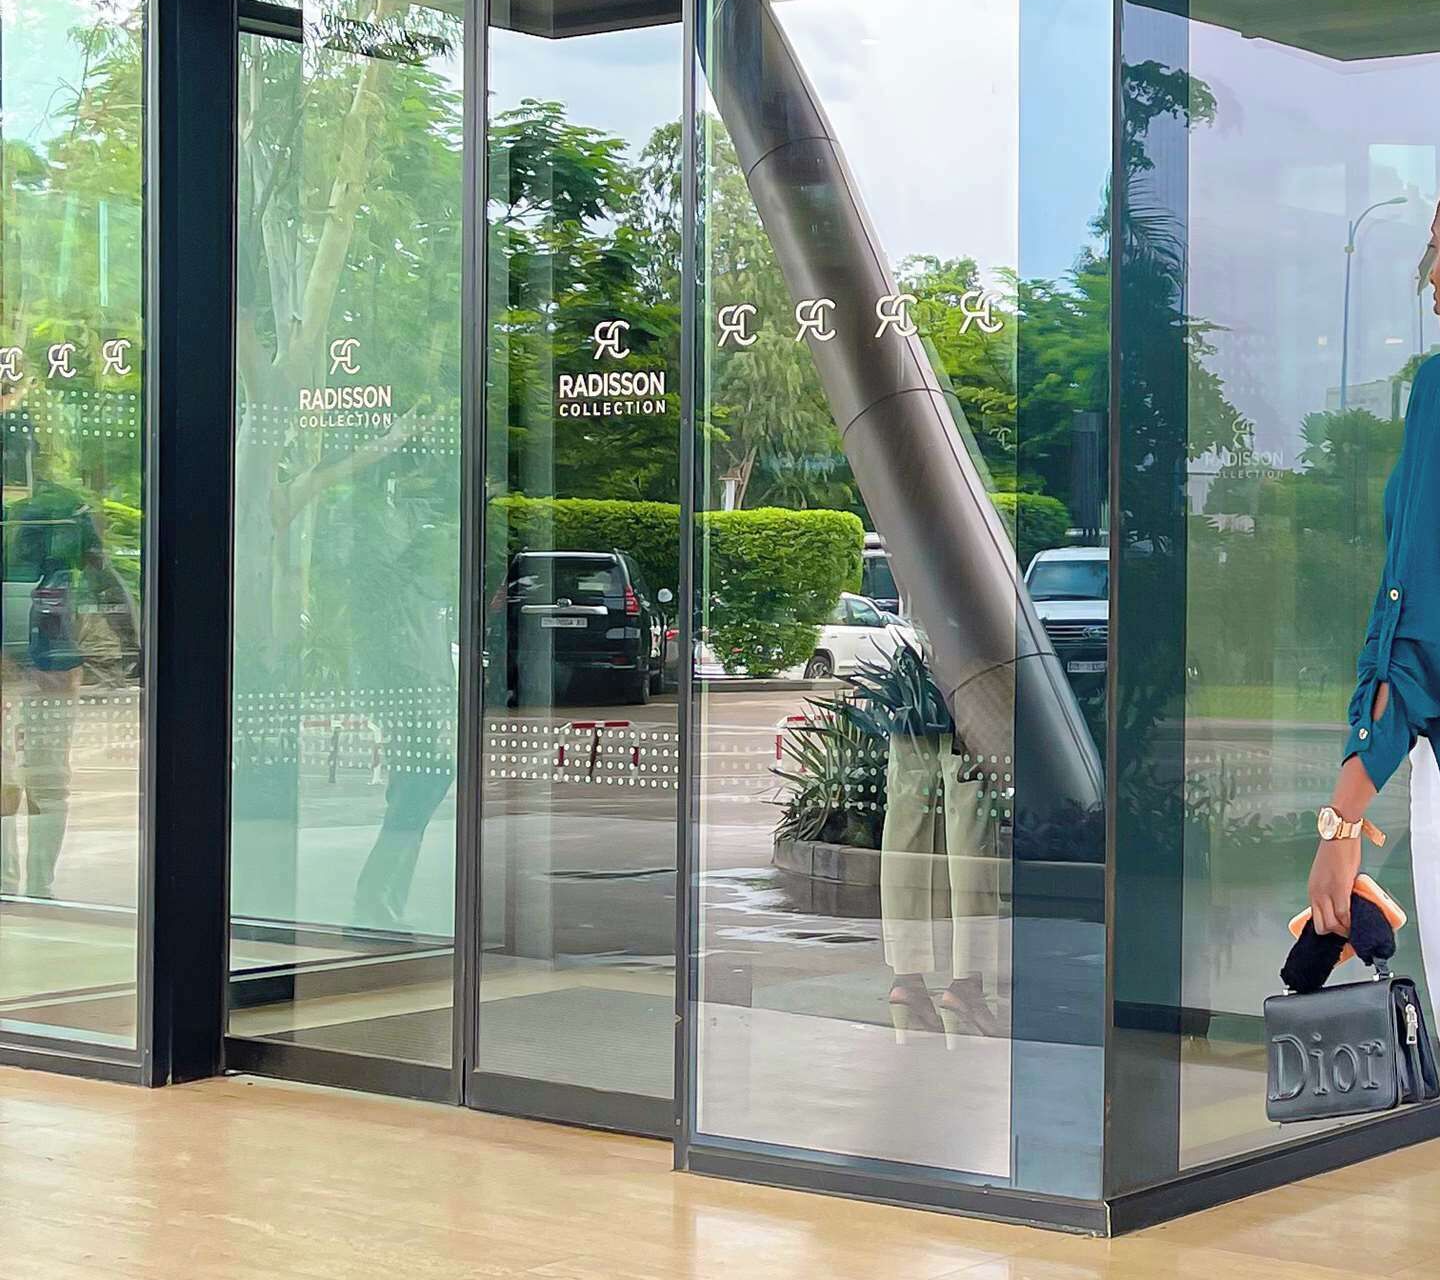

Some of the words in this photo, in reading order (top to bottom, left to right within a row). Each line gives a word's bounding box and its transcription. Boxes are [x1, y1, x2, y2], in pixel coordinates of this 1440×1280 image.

[559, 371, 665, 398] RADISSON
[299, 385, 392, 410] RADISSON
[559, 400, 666, 417] COLLECTION
[299, 412, 393, 428] COLLECTION
[1205, 449, 1284, 467] DISSON
[1268, 1031, 1385, 1102] Dior
